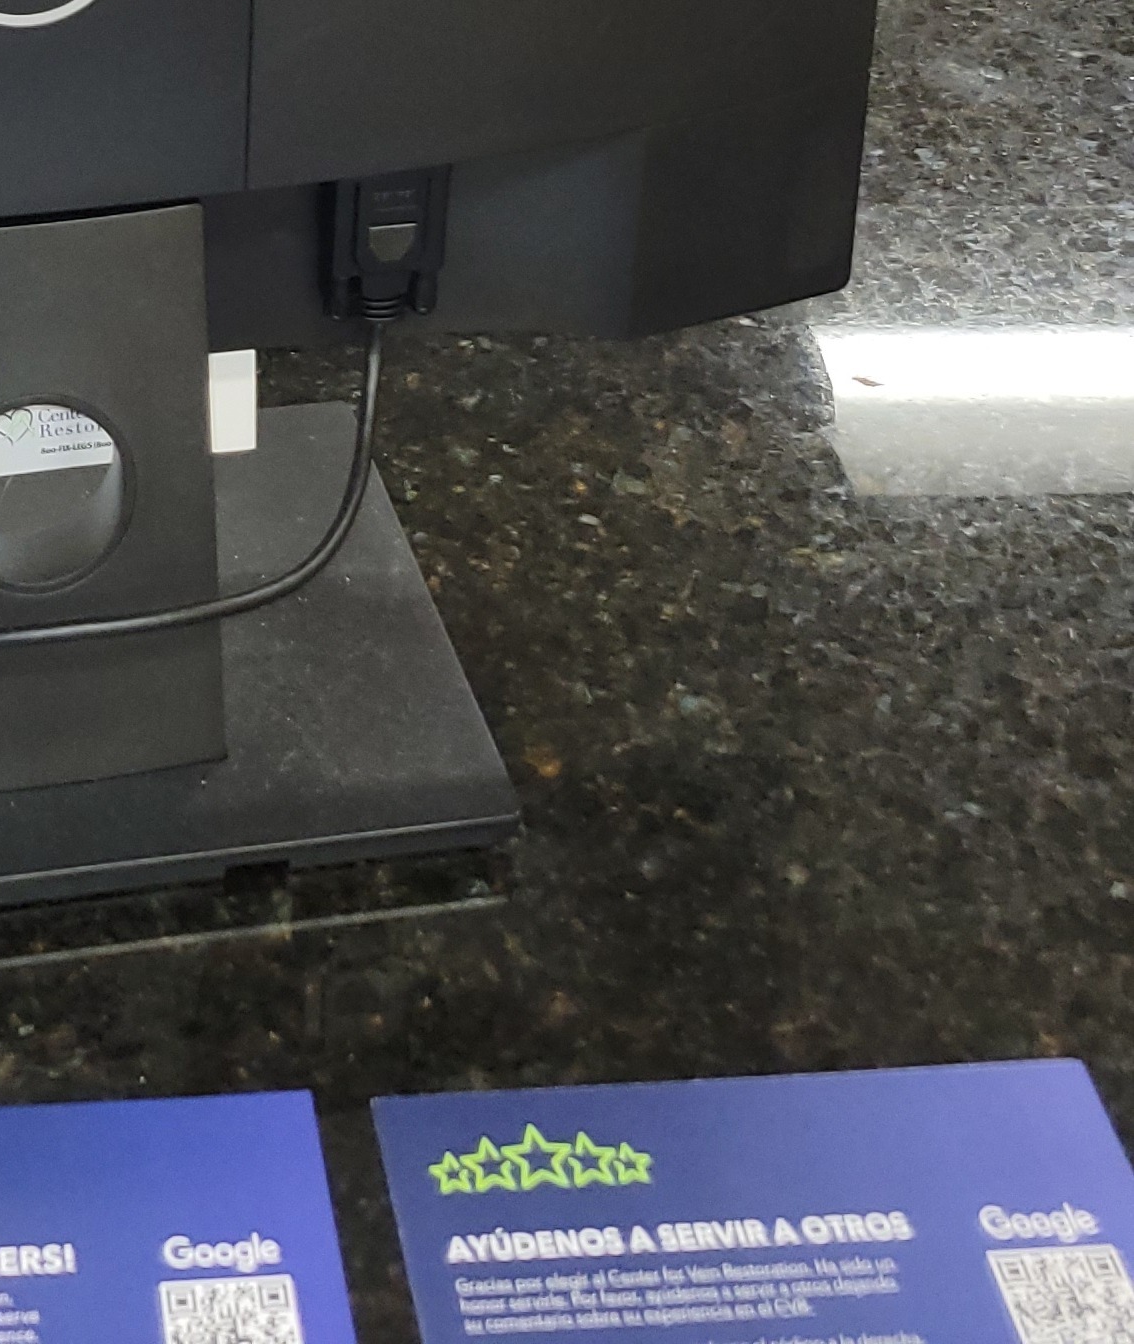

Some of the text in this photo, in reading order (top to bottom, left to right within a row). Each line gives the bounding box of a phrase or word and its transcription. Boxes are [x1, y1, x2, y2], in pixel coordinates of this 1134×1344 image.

[446, 1211, 915, 1264] AYÚDENOS A SERVIR A OTROS
[978, 1201, 1101, 1244] Google
[163, 1231, 283, 1273] Google
[607, 1269, 661, 1289] Center
[685, 1264, 722, 1284] Vein
